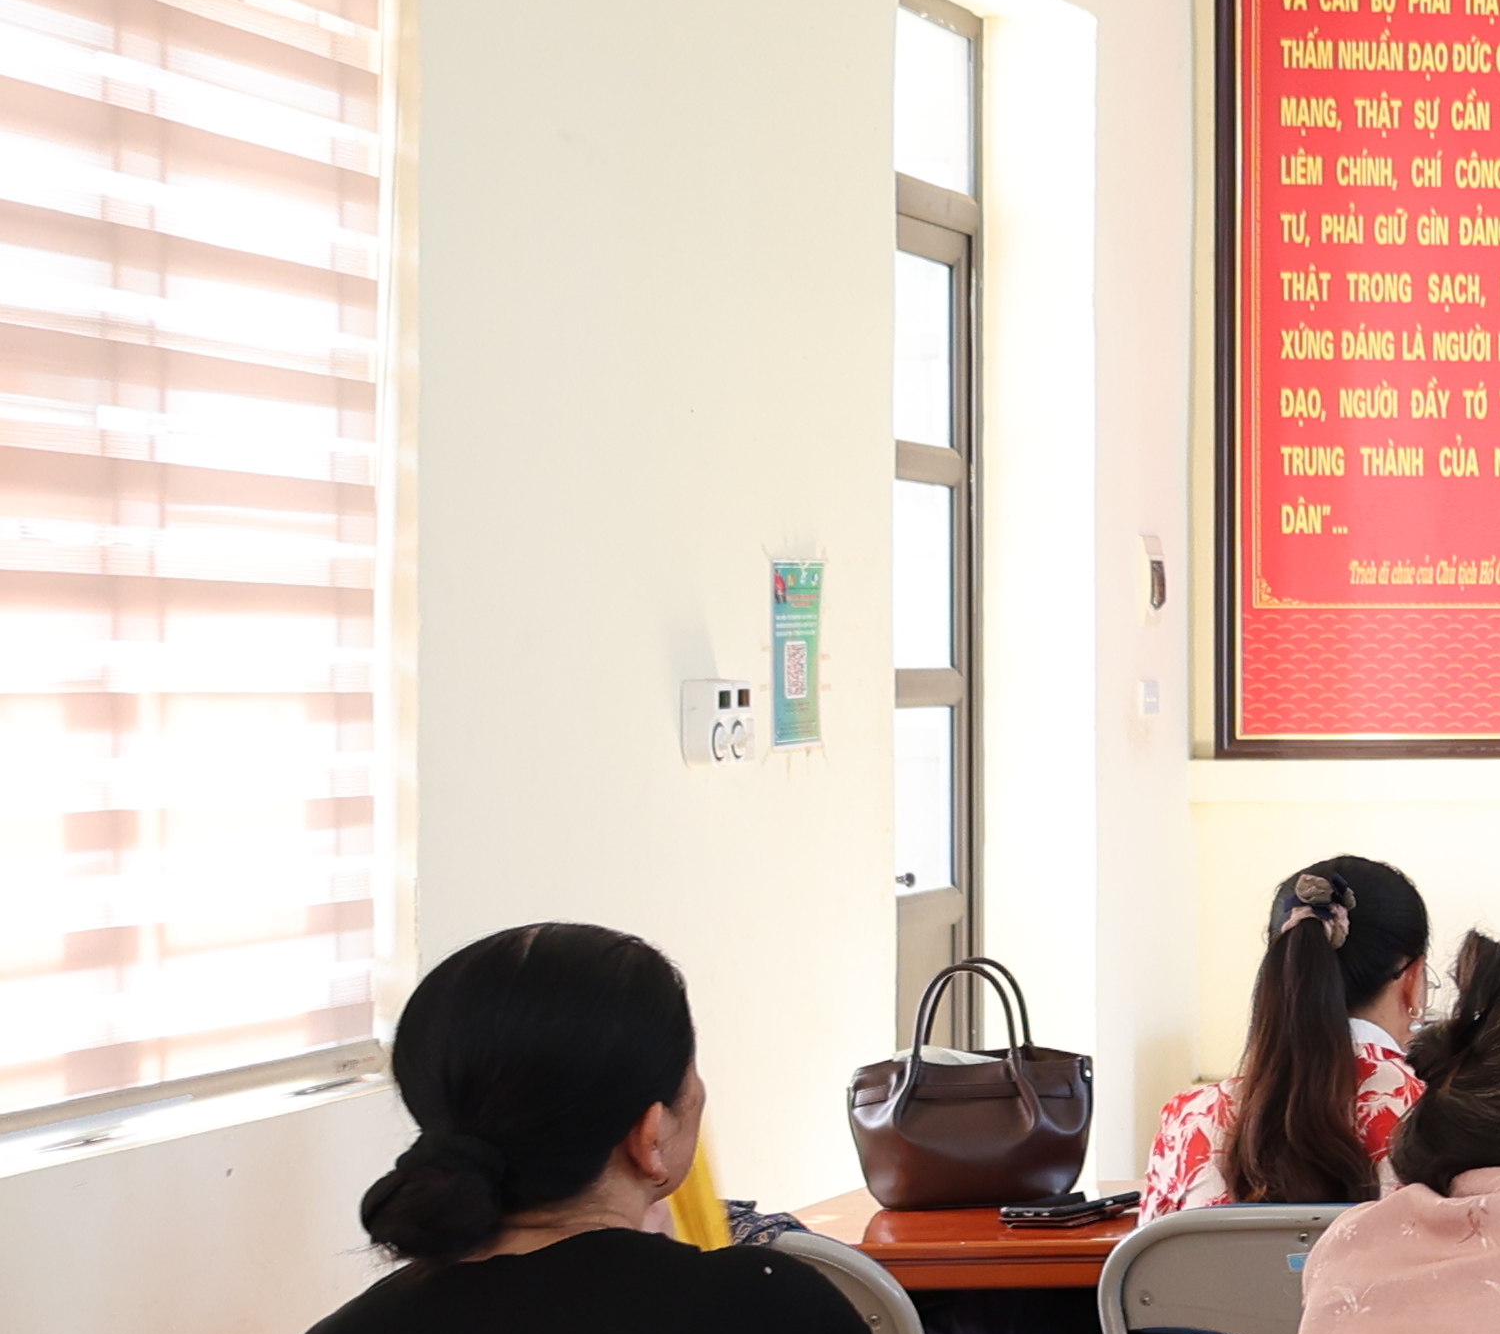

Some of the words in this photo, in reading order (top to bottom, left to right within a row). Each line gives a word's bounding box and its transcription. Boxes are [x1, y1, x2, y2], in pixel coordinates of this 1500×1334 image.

[1280, 27, 1333, 69] THẤM
[1337, 28, 1404, 71] NHUẦN
[1407, 41, 1448, 81] ĐẠO
[1451, 35, 1492, 73] ĐỨC
[1279, 263, 1331, 311] THẬT
[1345, 272, 1412, 303] TRONG
[1427, 272, 1486, 313] SẠCH,
[1281, 322, 1334, 360] XỨNG
[1340, 322, 1395, 361] ĐÁNG
[1401, 322, 1426, 361] LÀ
[1432, 323, 1491, 362] NGƯỜI
[1279, 387, 1326, 427] ĐẠO,
[1339, 379, 1398, 419] NGƯỜI
[1409, 376, 1450, 419] ĐẦY
[1461, 381, 1488, 420] TỚ
[1280, 446, 1345, 477] TRUNG
[1359, 438, 1424, 477] THÀNH
[1438, 434, 1480, 477] CỦA
[1281, 496, 1348, 534] DÂN”...
